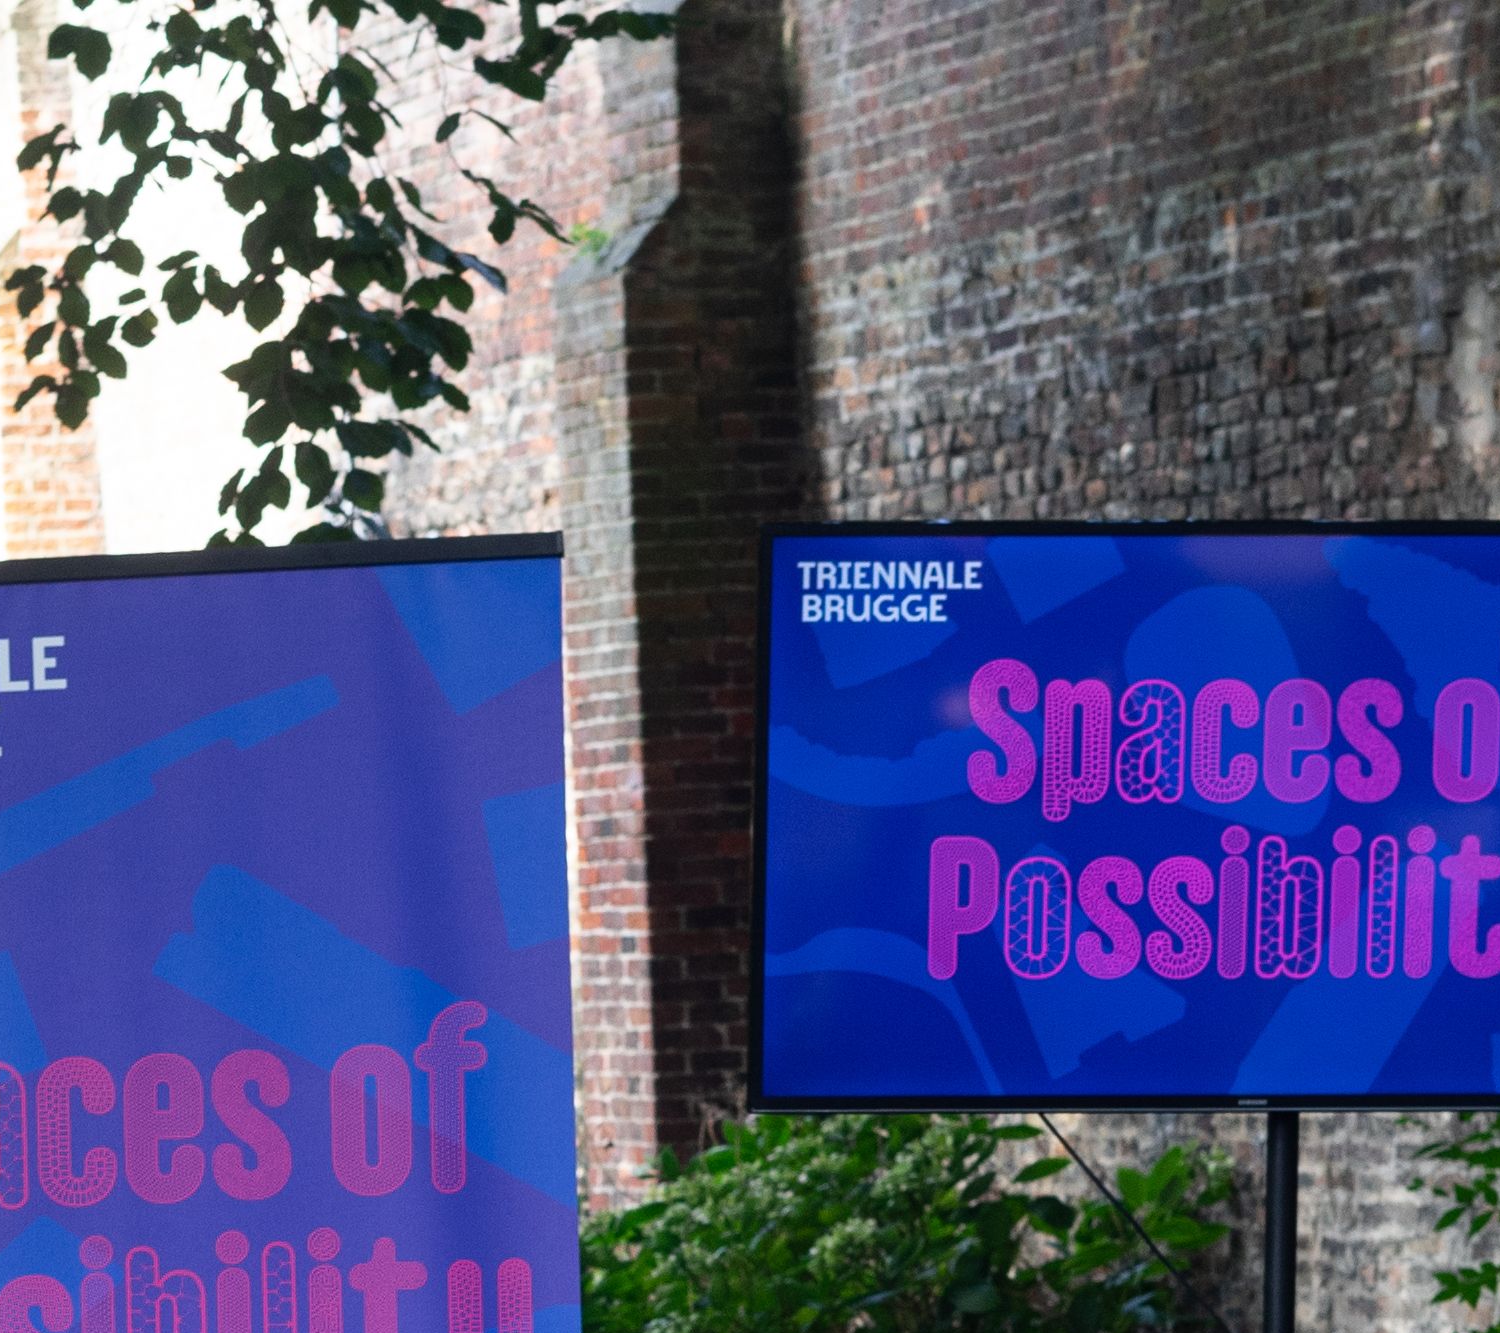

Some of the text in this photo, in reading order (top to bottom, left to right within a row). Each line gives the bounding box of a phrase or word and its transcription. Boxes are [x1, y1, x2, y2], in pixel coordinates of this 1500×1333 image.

[798, 561, 982, 589] TRIENNALE
[803, 594, 947, 622] BRUGGE
[967, 658, 1403, 822] Spaces
[329, 1001, 488, 1196] of
